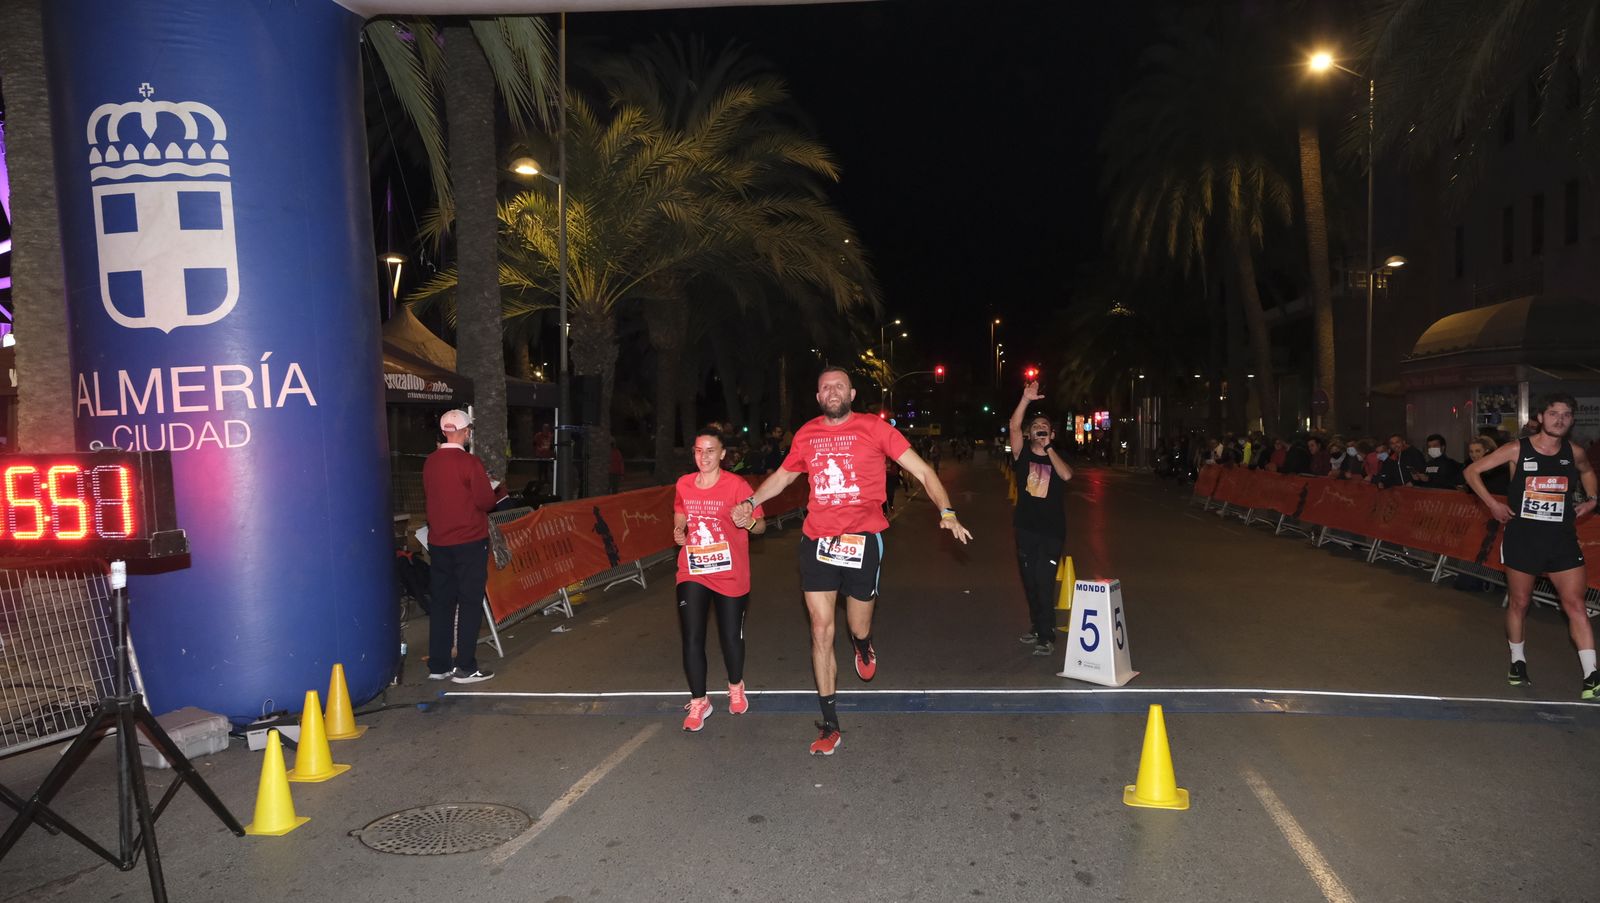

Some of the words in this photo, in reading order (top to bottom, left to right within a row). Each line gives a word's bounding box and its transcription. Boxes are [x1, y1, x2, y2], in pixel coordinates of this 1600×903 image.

[77, 351, 317, 418] ALMERÍA
[112, 420, 251, 451] CIUDAD
[0, 464, 134, 540] 5:51
[1531, 501, 1557, 512] 541
[696, 552, 724, 563] 3548
[1076, 583, 1106, 593] MONDO
[1080, 608, 1100, 652] 5
[1114, 607, 1124, 651] 5
